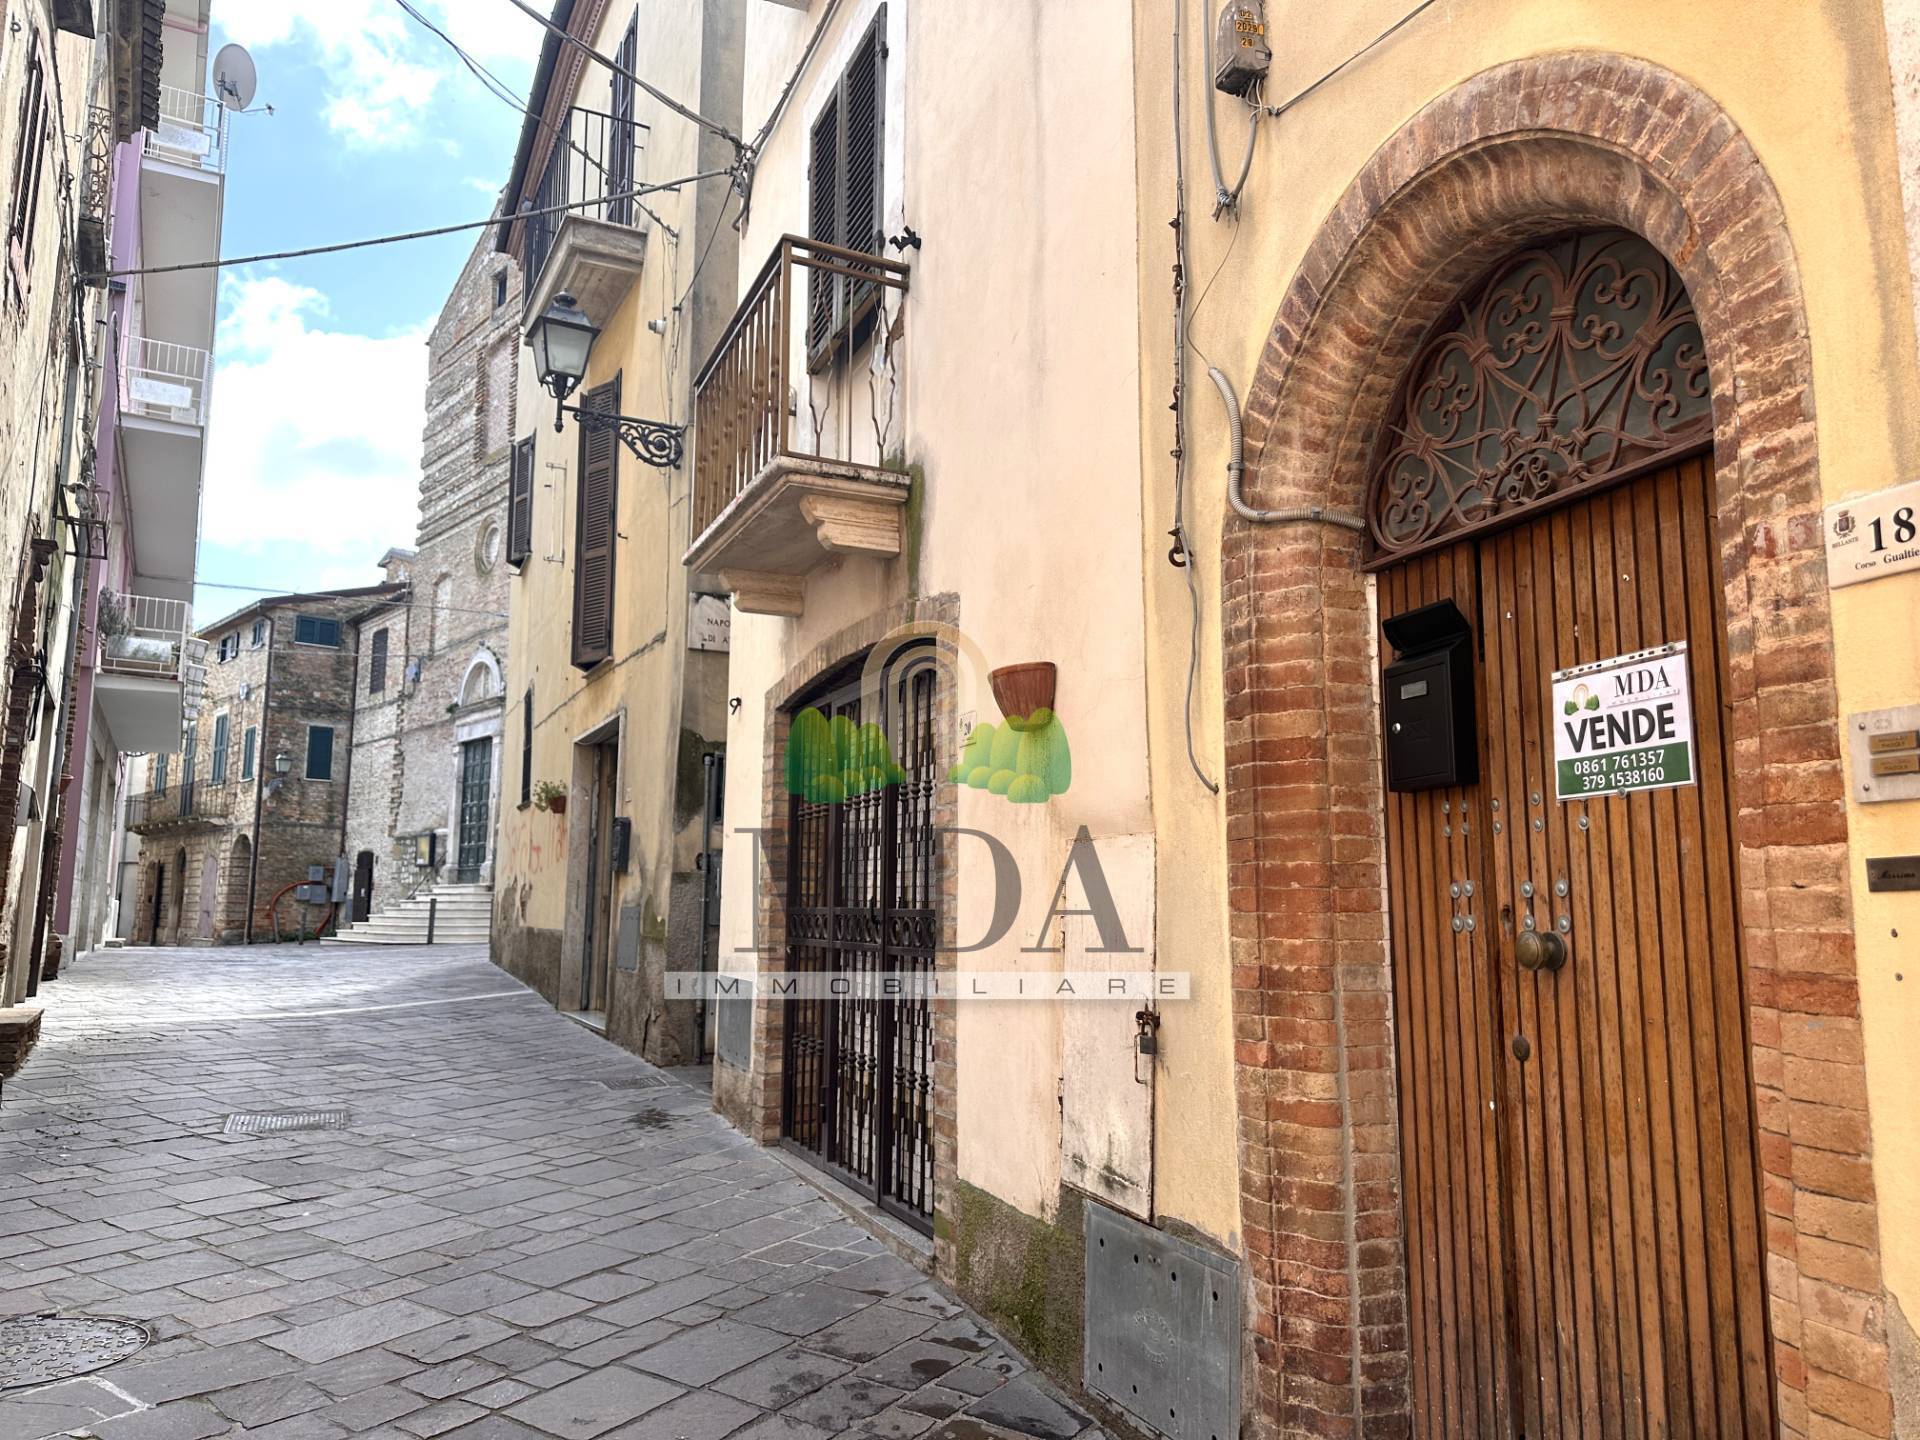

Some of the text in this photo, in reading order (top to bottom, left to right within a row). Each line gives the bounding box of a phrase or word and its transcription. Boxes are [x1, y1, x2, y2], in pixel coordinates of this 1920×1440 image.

[1867, 507, 1916, 553] 18
[1855, 561, 1877, 570] Corso
[1613, 665, 1671, 697] MDA
[1564, 703, 1675, 753] VENDE
[1574, 750, 1665, 775] 0861 761357
[1583, 767, 1665, 790] 379 1538160
